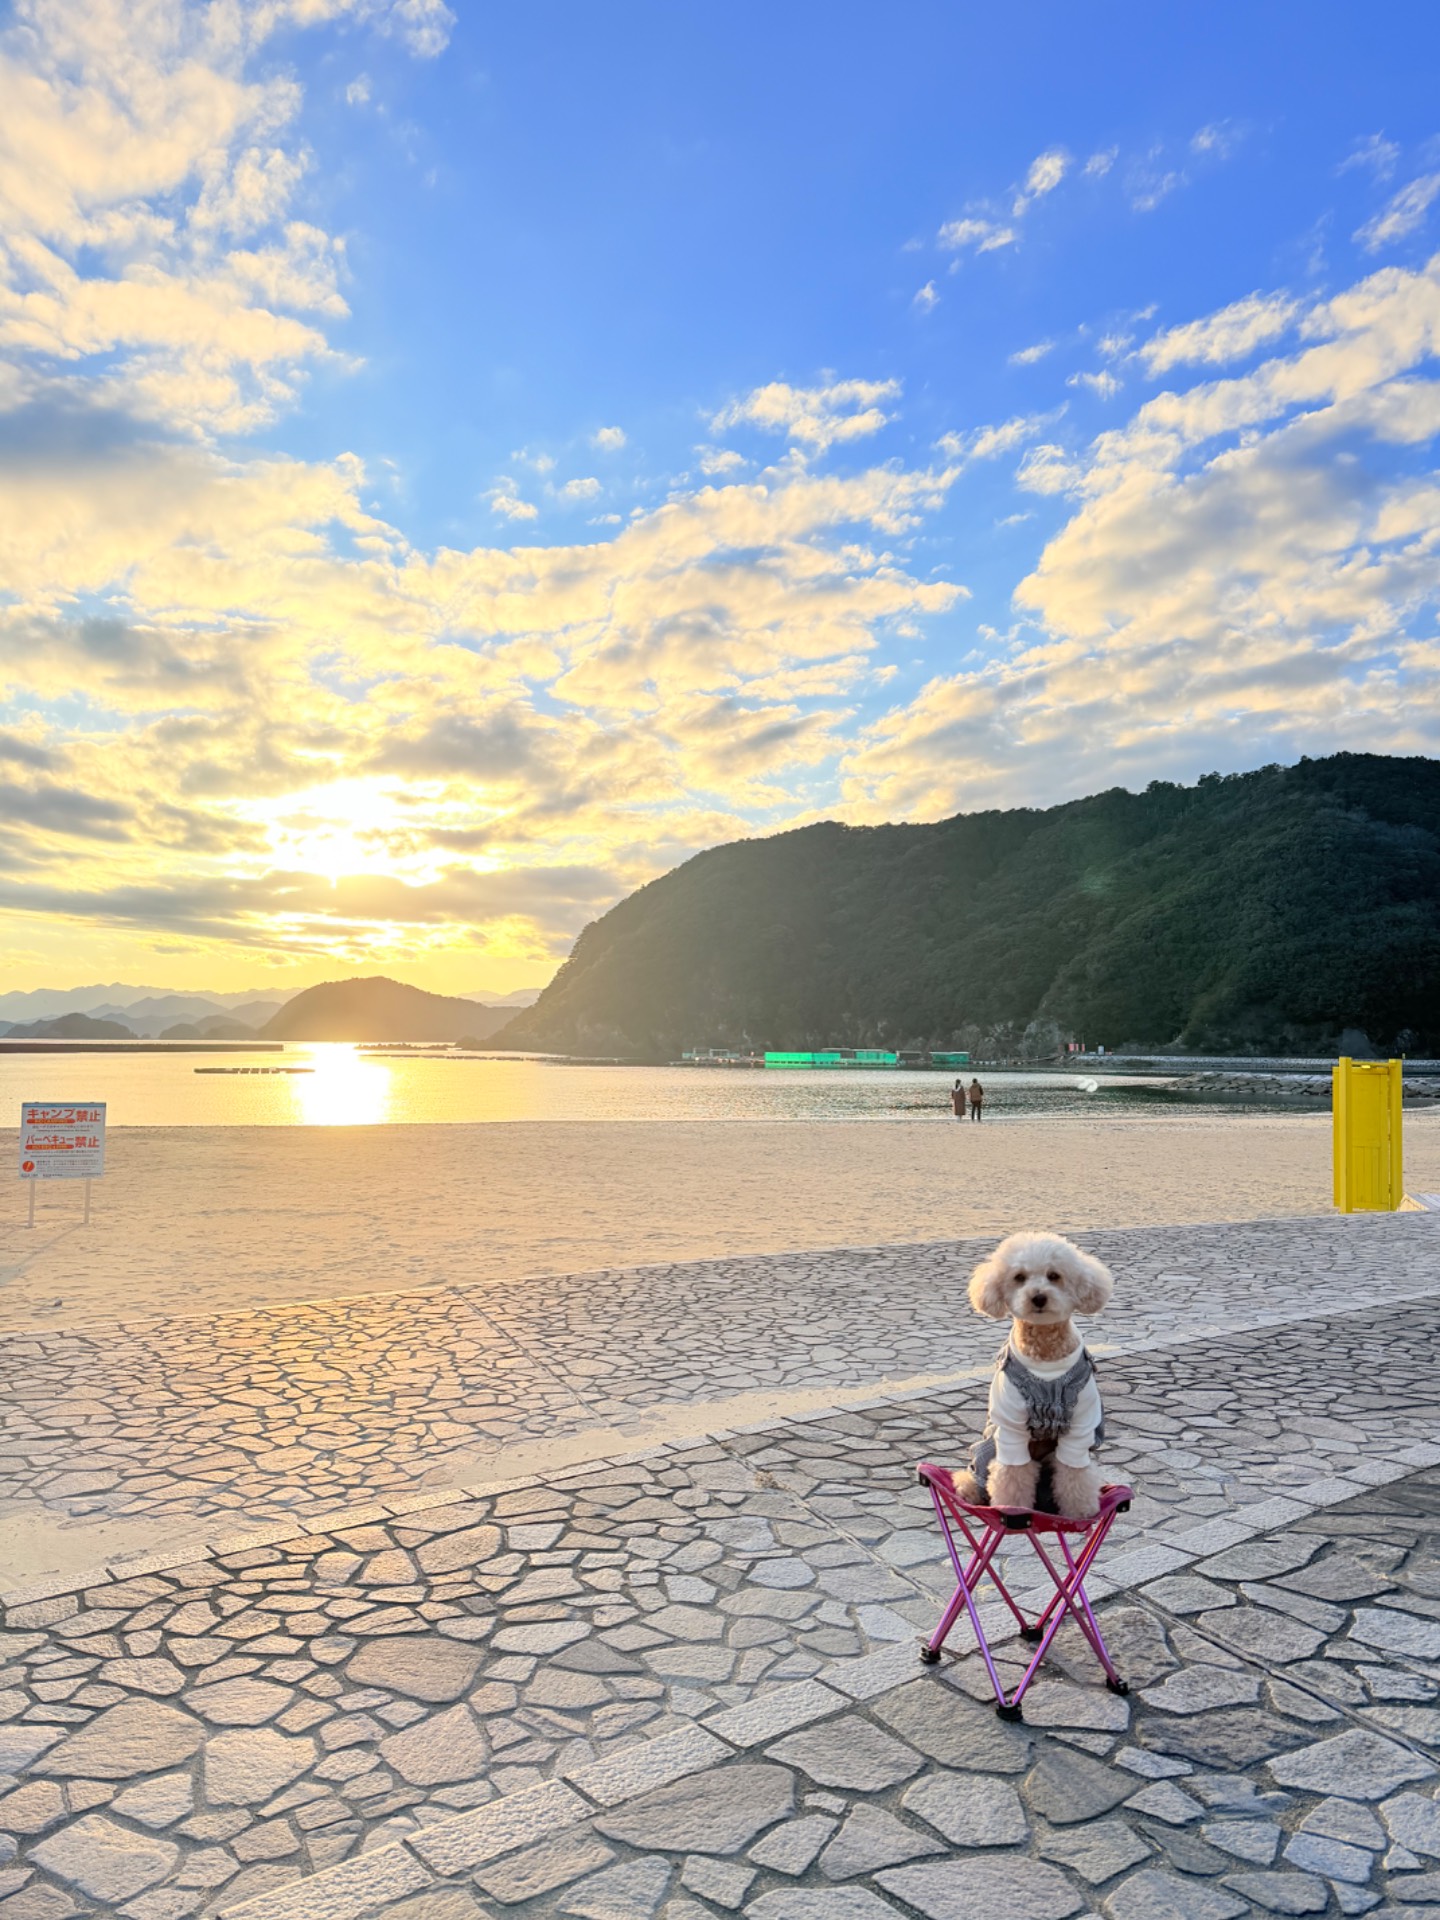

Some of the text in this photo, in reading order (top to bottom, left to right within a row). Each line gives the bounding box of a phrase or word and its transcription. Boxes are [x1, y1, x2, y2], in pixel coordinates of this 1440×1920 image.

[27, 1108, 101, 1122] キャンプ禁止
[26, 1134, 100, 1148] バーベキュー禁止
